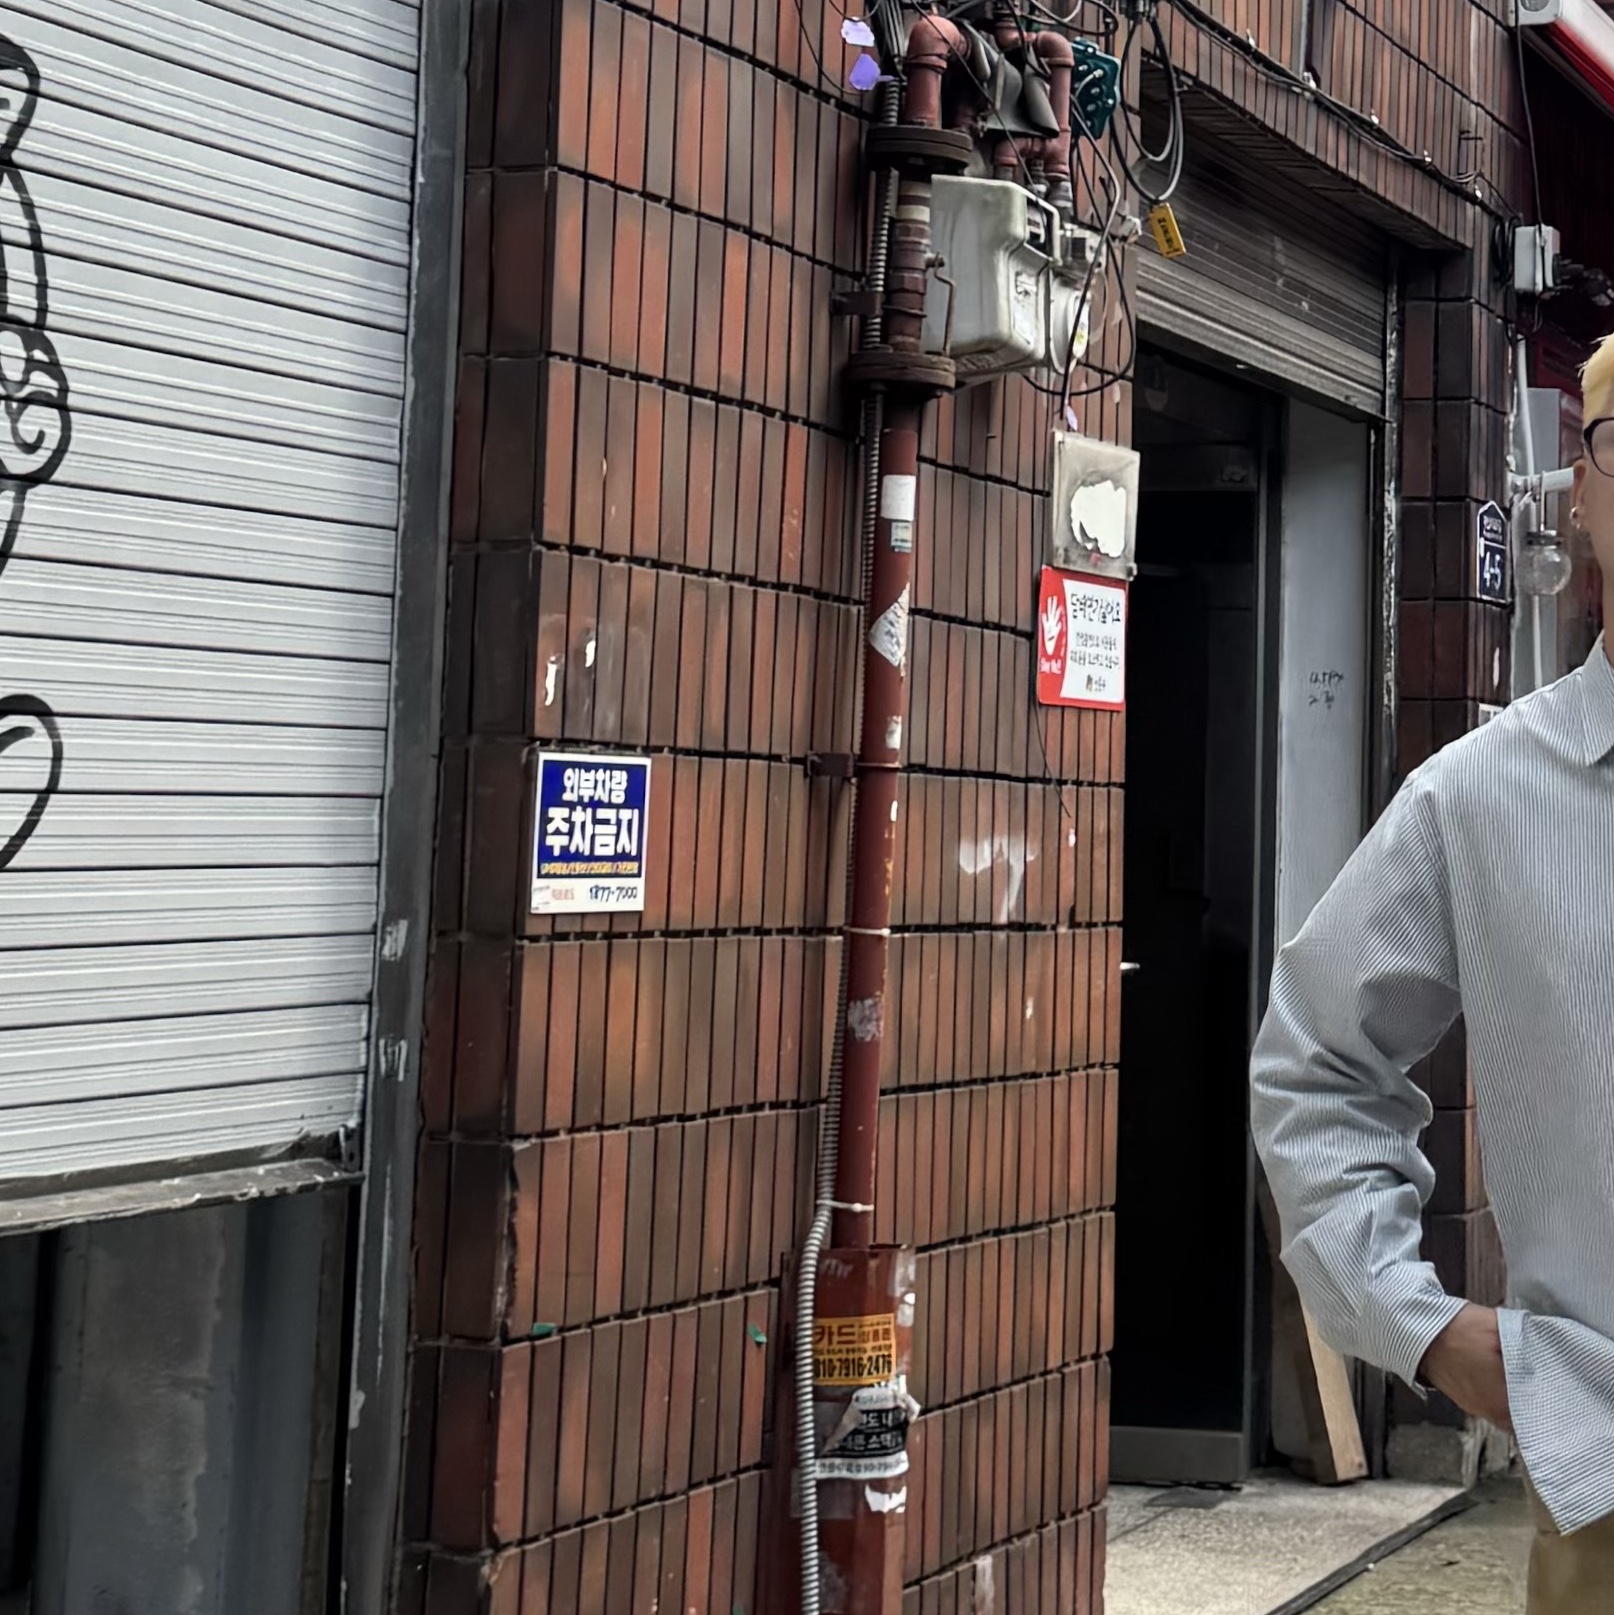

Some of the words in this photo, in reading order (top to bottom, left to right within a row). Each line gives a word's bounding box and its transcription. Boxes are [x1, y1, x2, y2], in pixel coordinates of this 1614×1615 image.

[562, 767, 628, 804] 외부차량
[544, 806, 640, 857] 주차금지
[815, 1325, 857, 1346] 카드
